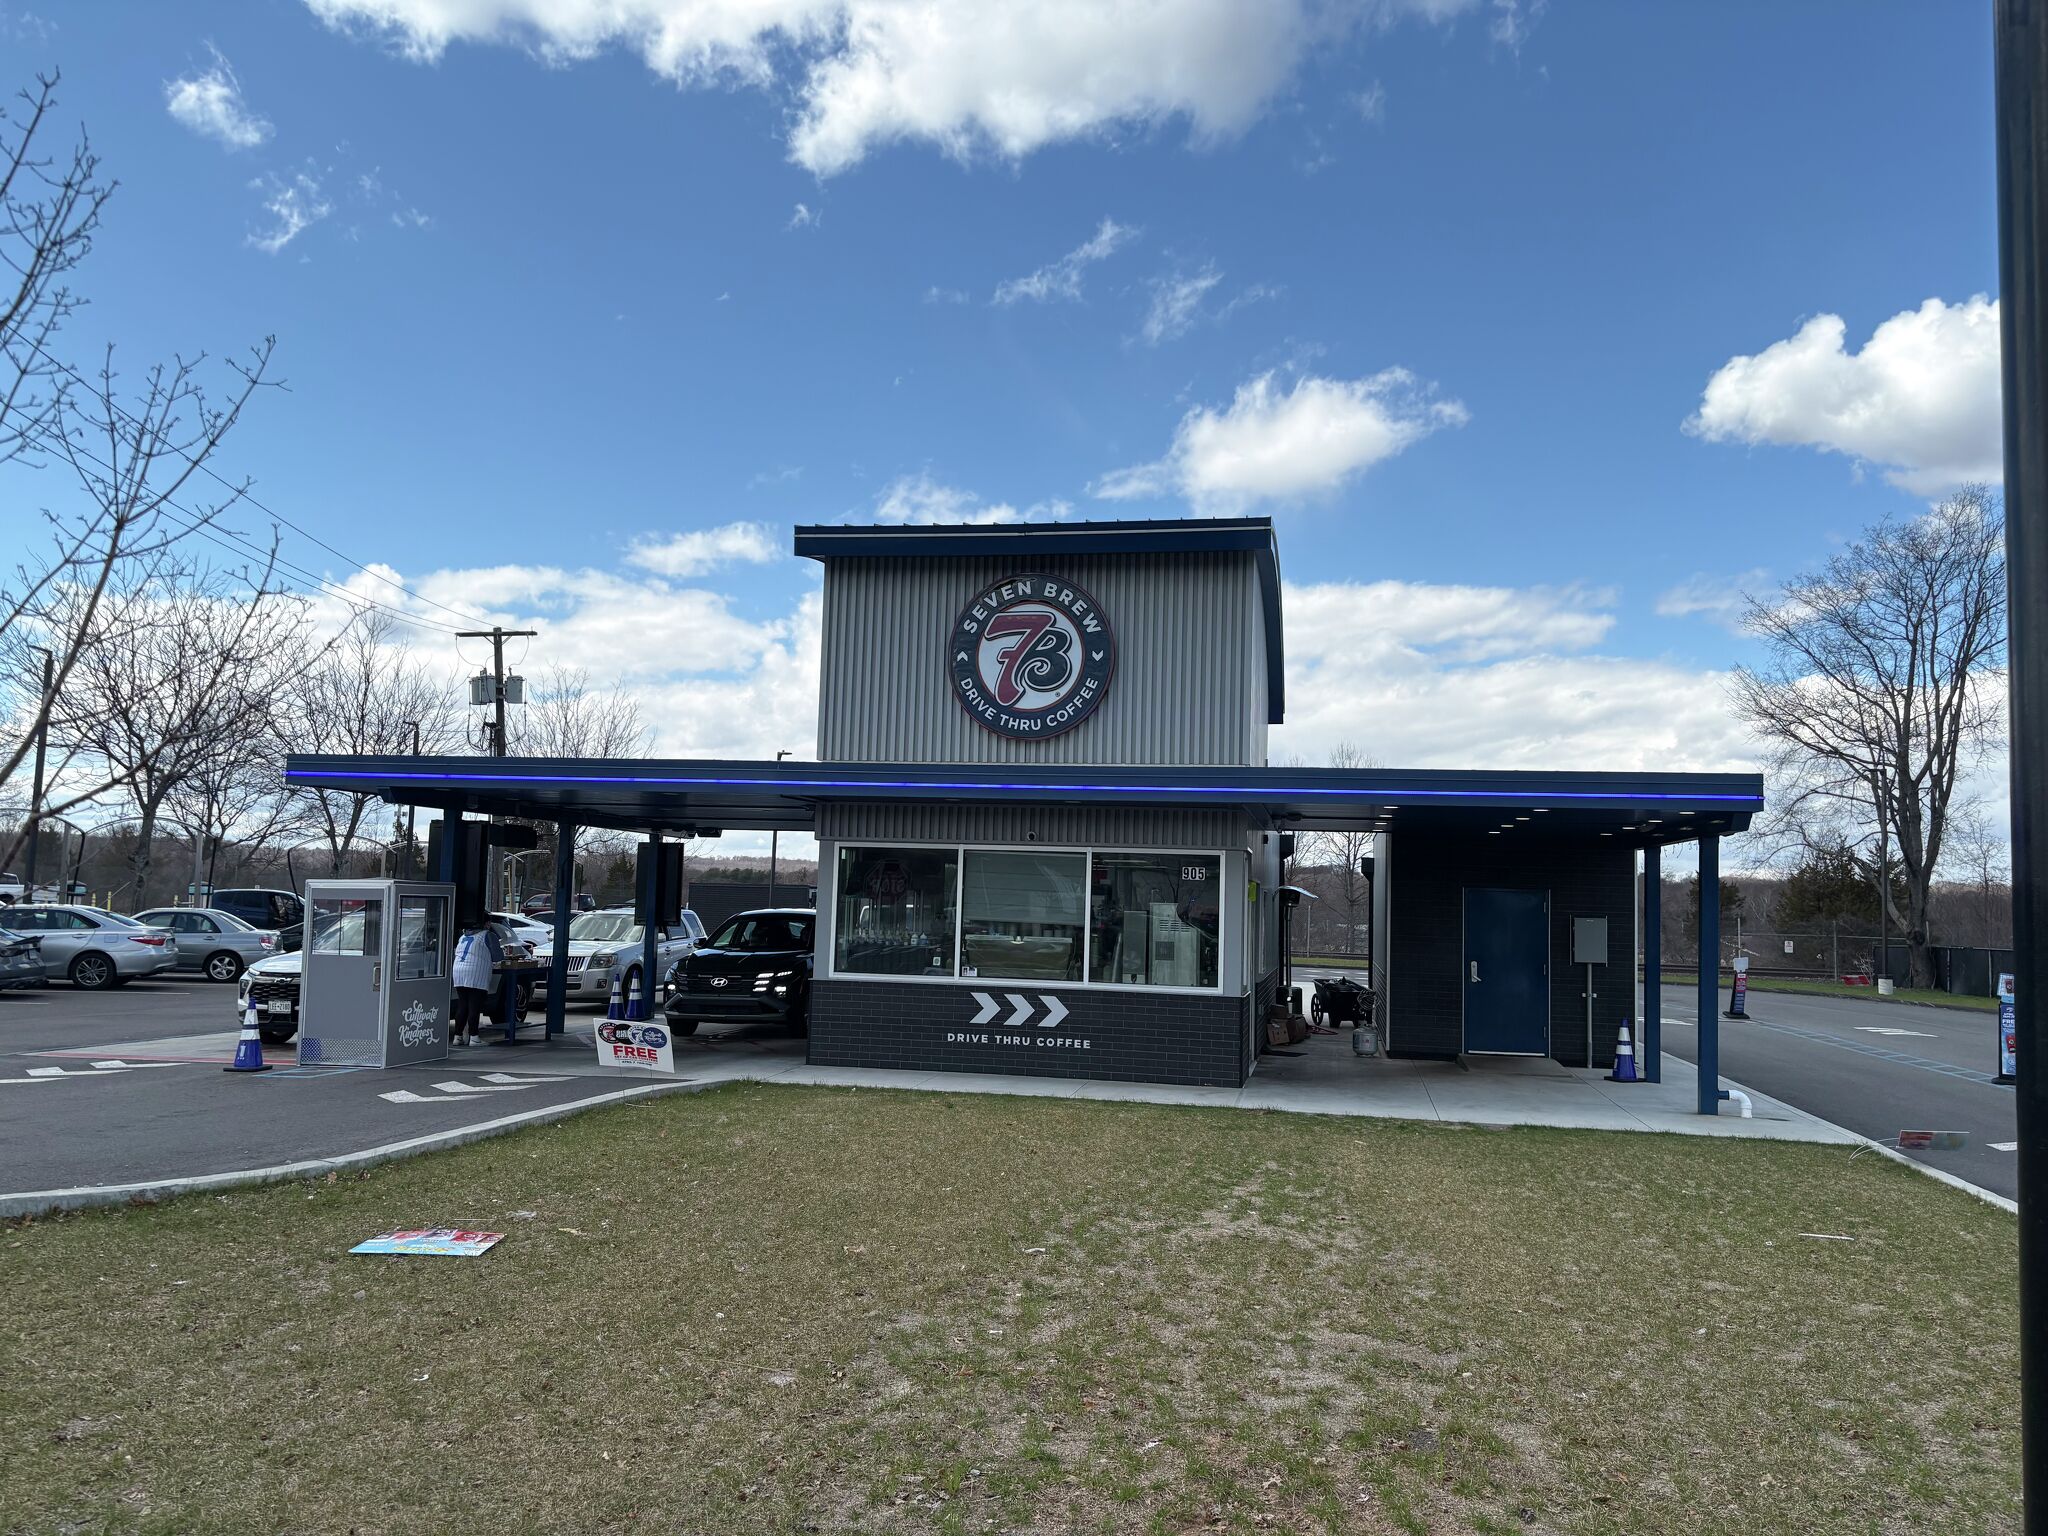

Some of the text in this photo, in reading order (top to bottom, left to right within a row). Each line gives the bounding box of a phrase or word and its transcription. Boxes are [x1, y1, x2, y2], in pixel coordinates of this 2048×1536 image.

[963, 581, 1102, 634] SEVEN BREW
[960, 677, 1099, 731] DRIVE THRU COFFEE
[1183, 867, 1204, 880] 905
[461, 936, 475, 963] 7
[401, 1000, 440, 1024] Cultivate
[398, 1021, 440, 1047] Kindness
[947, 1033, 1091, 1049] DRIVE THRU COFFEE
[613, 1045, 658, 1060] FREE
